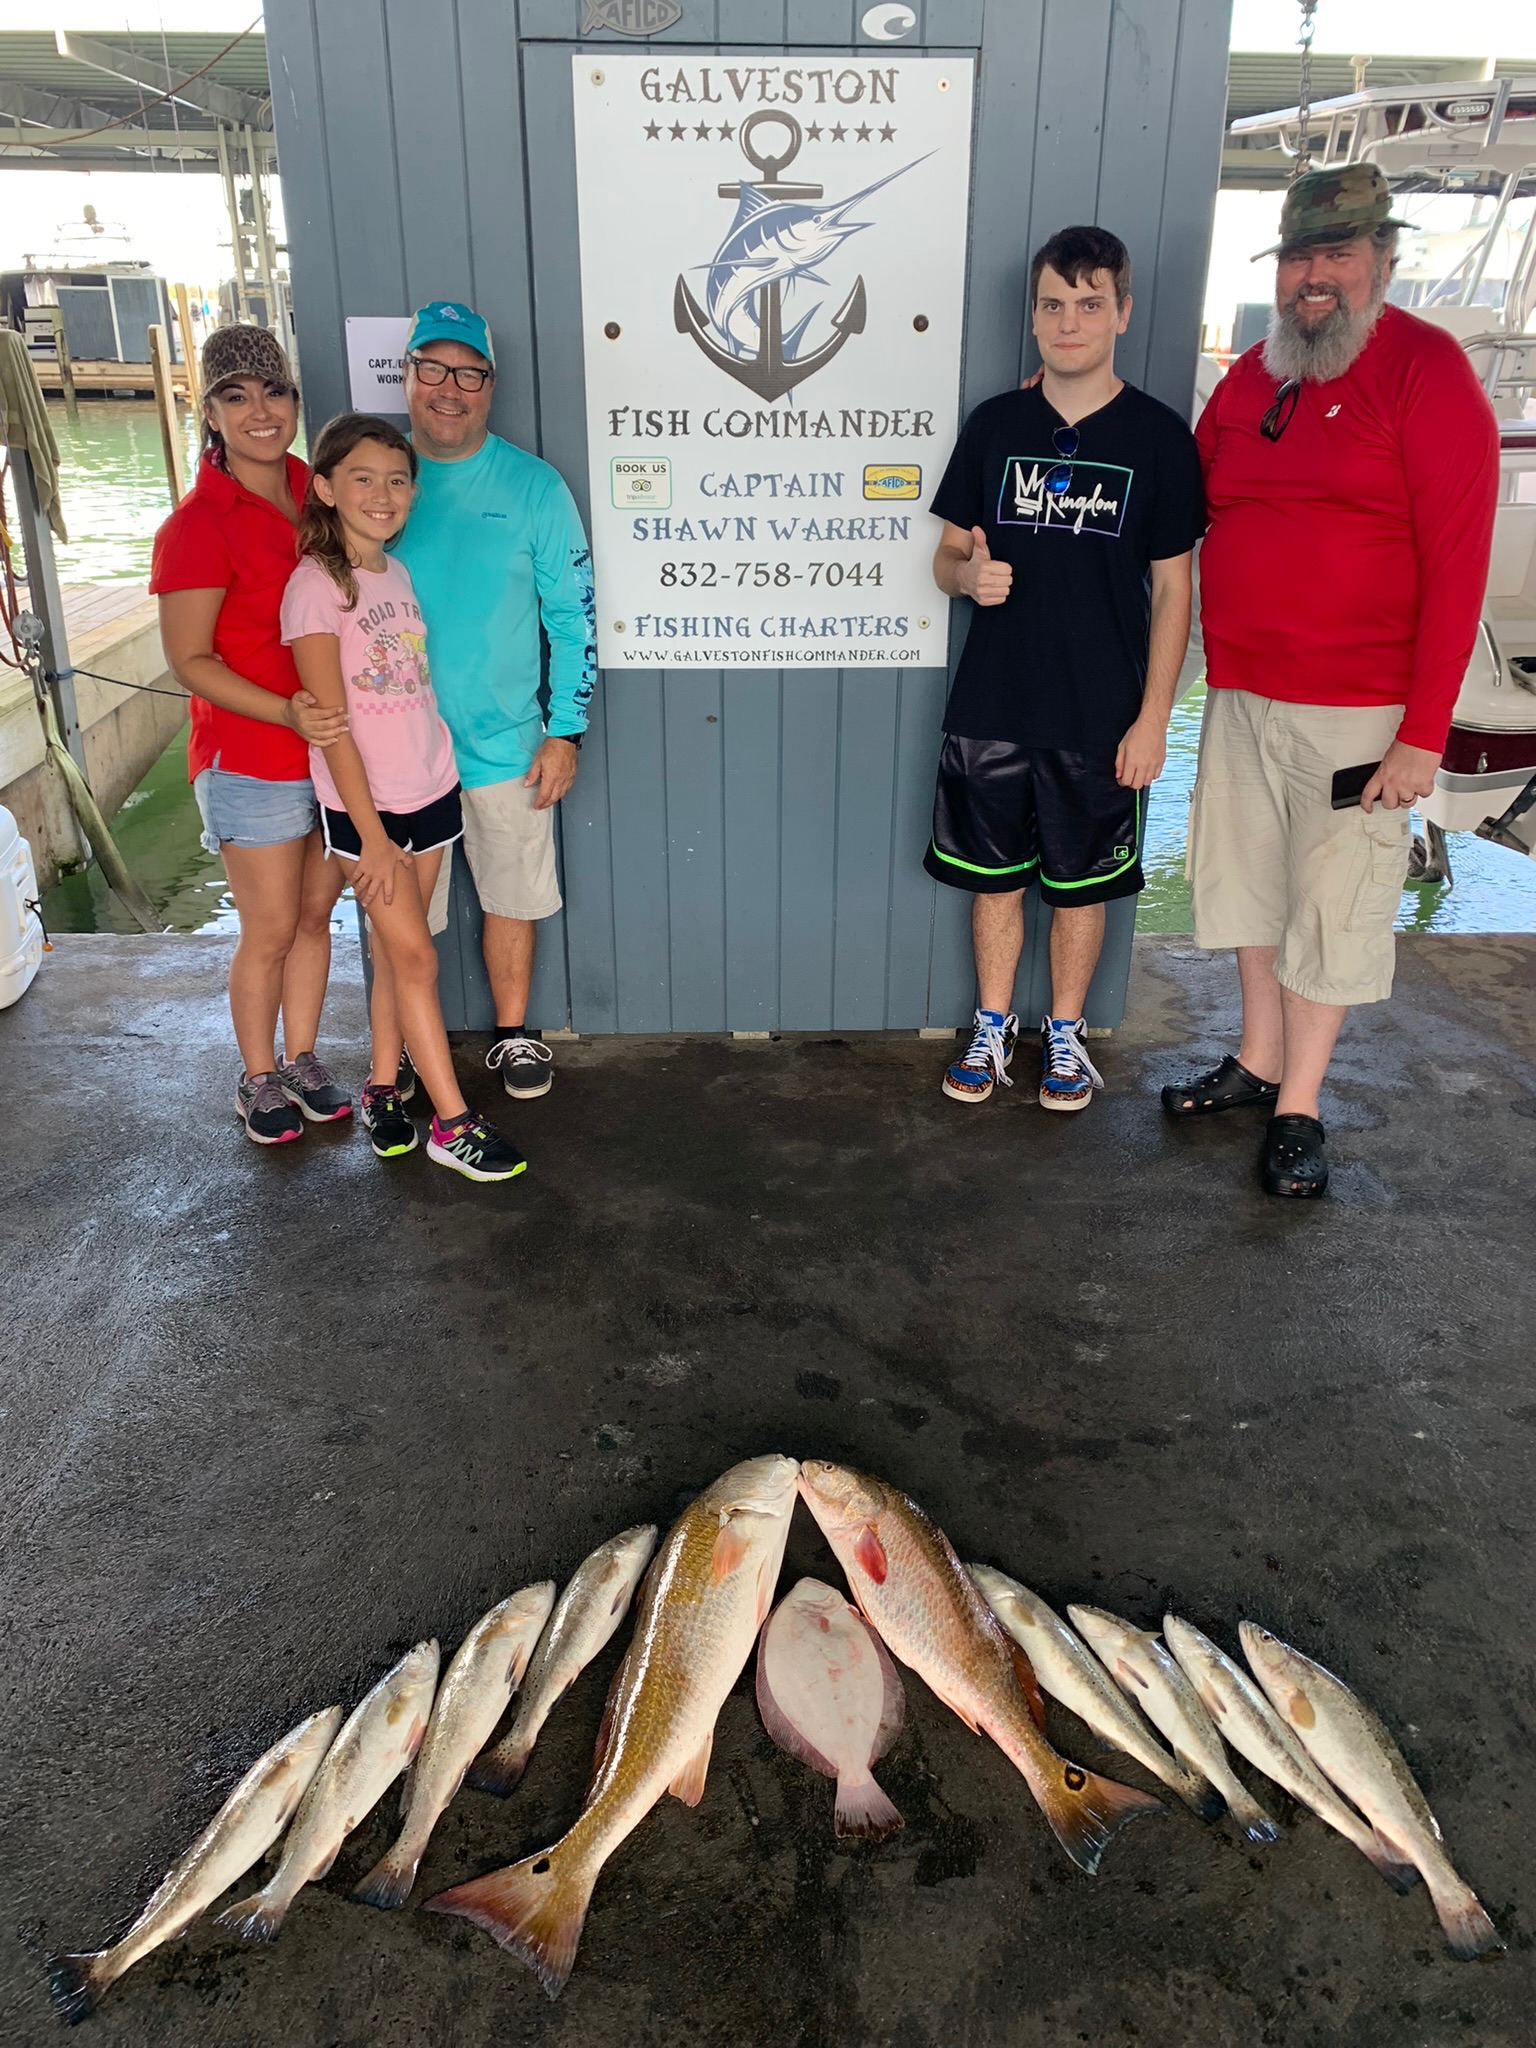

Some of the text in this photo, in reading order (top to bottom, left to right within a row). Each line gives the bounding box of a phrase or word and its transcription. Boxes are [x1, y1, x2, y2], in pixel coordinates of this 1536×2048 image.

[640, 66, 900, 105] GALVESTON
[608, 405, 937, 439] FISH COMMANDER
[615, 464, 667, 473] BOOK US
[699, 472, 846, 499] CAPTAIN
[632, 516, 912, 542] SHAWN WARREN
[659, 562, 885, 588] 832-758-7044
[357, 601, 396, 635] ROAD
[634, 613, 909, 639] FISHING CHARTERS
[622, 649, 921, 663] WWW.GALVESTONFISHCOMMANDER.COM
